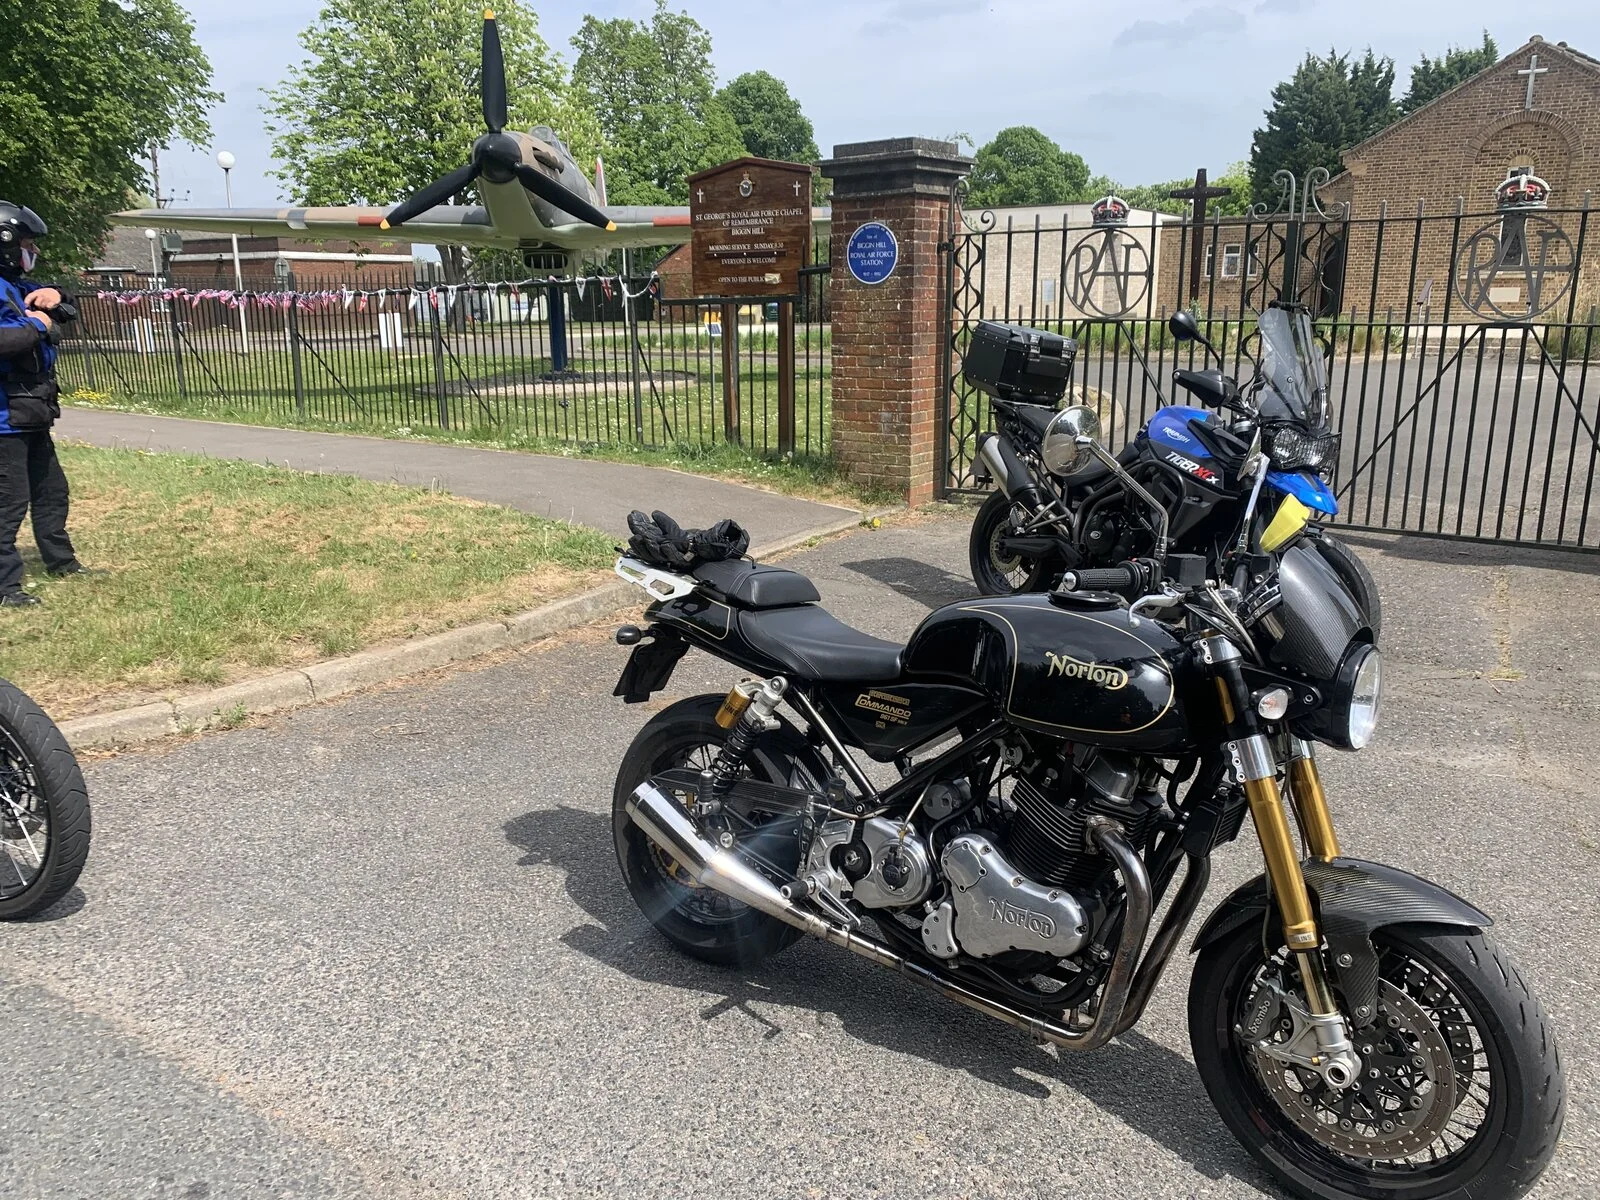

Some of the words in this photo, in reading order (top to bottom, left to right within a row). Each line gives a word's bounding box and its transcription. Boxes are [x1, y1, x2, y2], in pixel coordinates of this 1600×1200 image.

[703, 212, 730, 220] GEORGE'S
[731, 211, 749, 219] ROYAL
[750, 210, 760, 218] AIR
[760, 209, 779, 217] FORCE
[780, 208, 803, 216] CHAPEL
[722, 219, 730, 227] OF
[731, 217, 774, 226] REMEMBRANCE
[731, 228, 751, 236] BIGGIN
[751, 227, 765, 235] HILL
[1162, 426, 1191, 443] TRIUMPH
[1045, 651, 1129, 690] Norton
[855, 693, 912, 719] COMMANDO
[988, 896, 1058, 939] Norton
[1248, 1000, 1271, 1034] brembo
